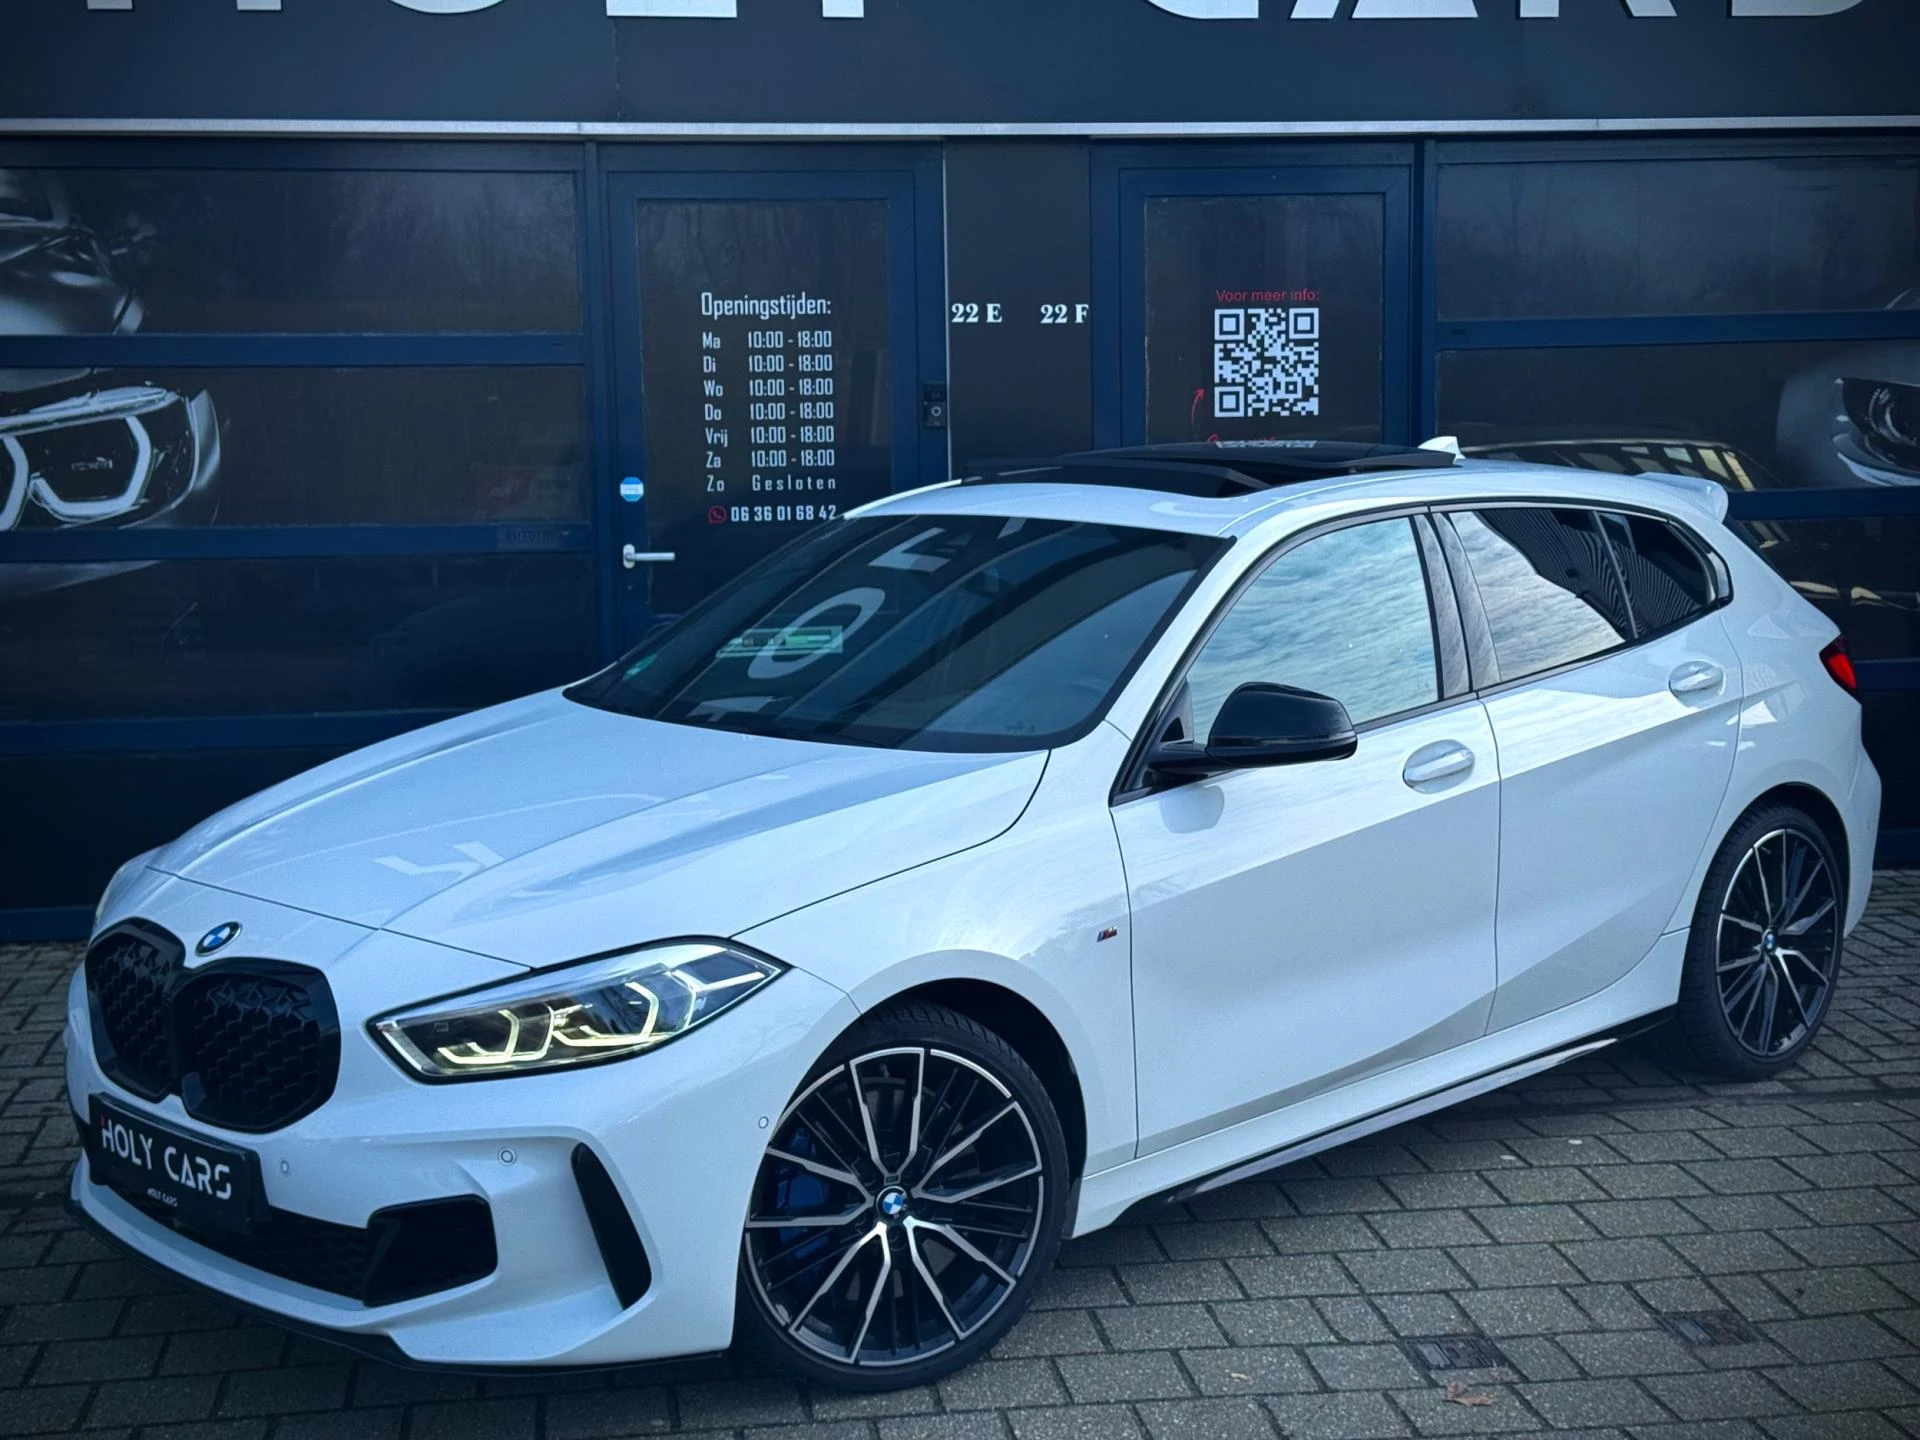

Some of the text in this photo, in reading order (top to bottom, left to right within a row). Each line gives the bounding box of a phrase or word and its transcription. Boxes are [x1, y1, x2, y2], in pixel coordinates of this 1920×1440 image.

[1215, 287, 1320, 302] Voor meer info:
[701, 291, 832, 320] Openingstijden:
[952, 304, 1002, 322] 22 E
[1041, 303, 1089, 323] 22 F
[703, 332, 720, 348] Ma
[749, 332, 783, 348] 10:00
[798, 331, 831, 347] 18:00
[703, 356, 716, 372] Di
[749, 355, 783, 371] 10:00
[799, 355, 832, 371] 18:00
[704, 380, 723, 396] Wo
[750, 380, 784, 396] 10:00
[800, 379, 832, 395] 18:00
[705, 404, 721, 420] Do
[751, 403, 785, 419] 10:00
[800, 402, 833, 418] 18:00
[706, 428, 727, 447] Vrij
[751, 427, 785, 443] 10:00
[801, 426, 834, 442] 18:00
[706, 451, 721, 468] Za
[752, 450, 786, 466] 10:00
[801, 450, 834, 465] 18:00
[707, 475, 835, 491] Zo Gesloten
[732, 505, 835, 521] 06 36 01 68 42
[101, 1115, 233, 1200] HOLY CARS
